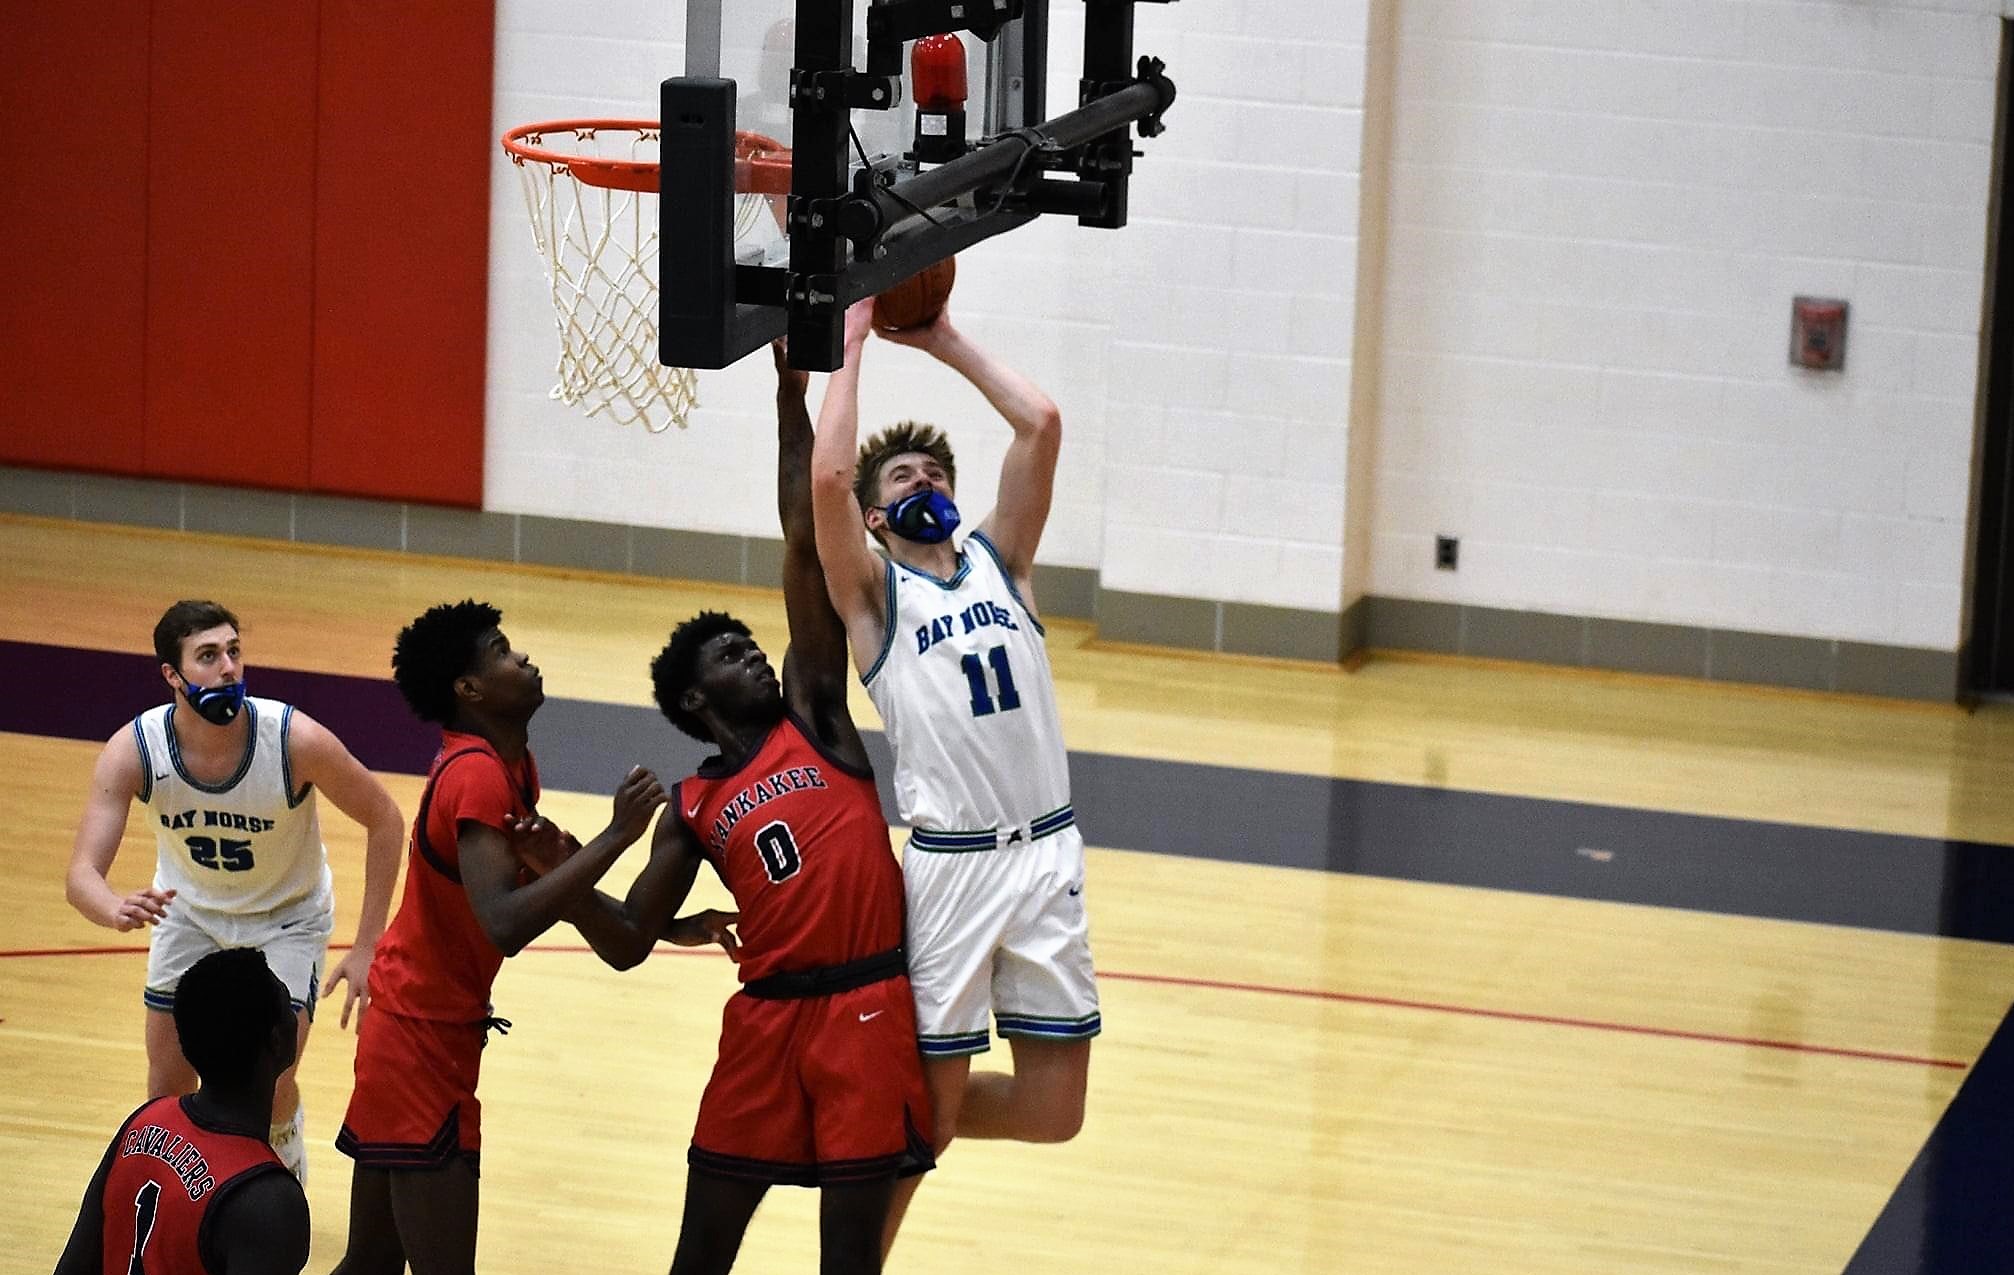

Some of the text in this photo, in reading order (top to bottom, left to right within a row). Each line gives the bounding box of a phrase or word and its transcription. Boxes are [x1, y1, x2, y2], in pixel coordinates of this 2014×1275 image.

[915, 614, 954, 656] BAY
[960, 644, 1022, 718] 11
[184, 835, 255, 872] 25
[203, 810, 275, 833] NORSE
[753, 819, 802, 884] 0
[122, 1125, 216, 1202] CAVALIERS
[127, 1179, 162, 1275] 1
